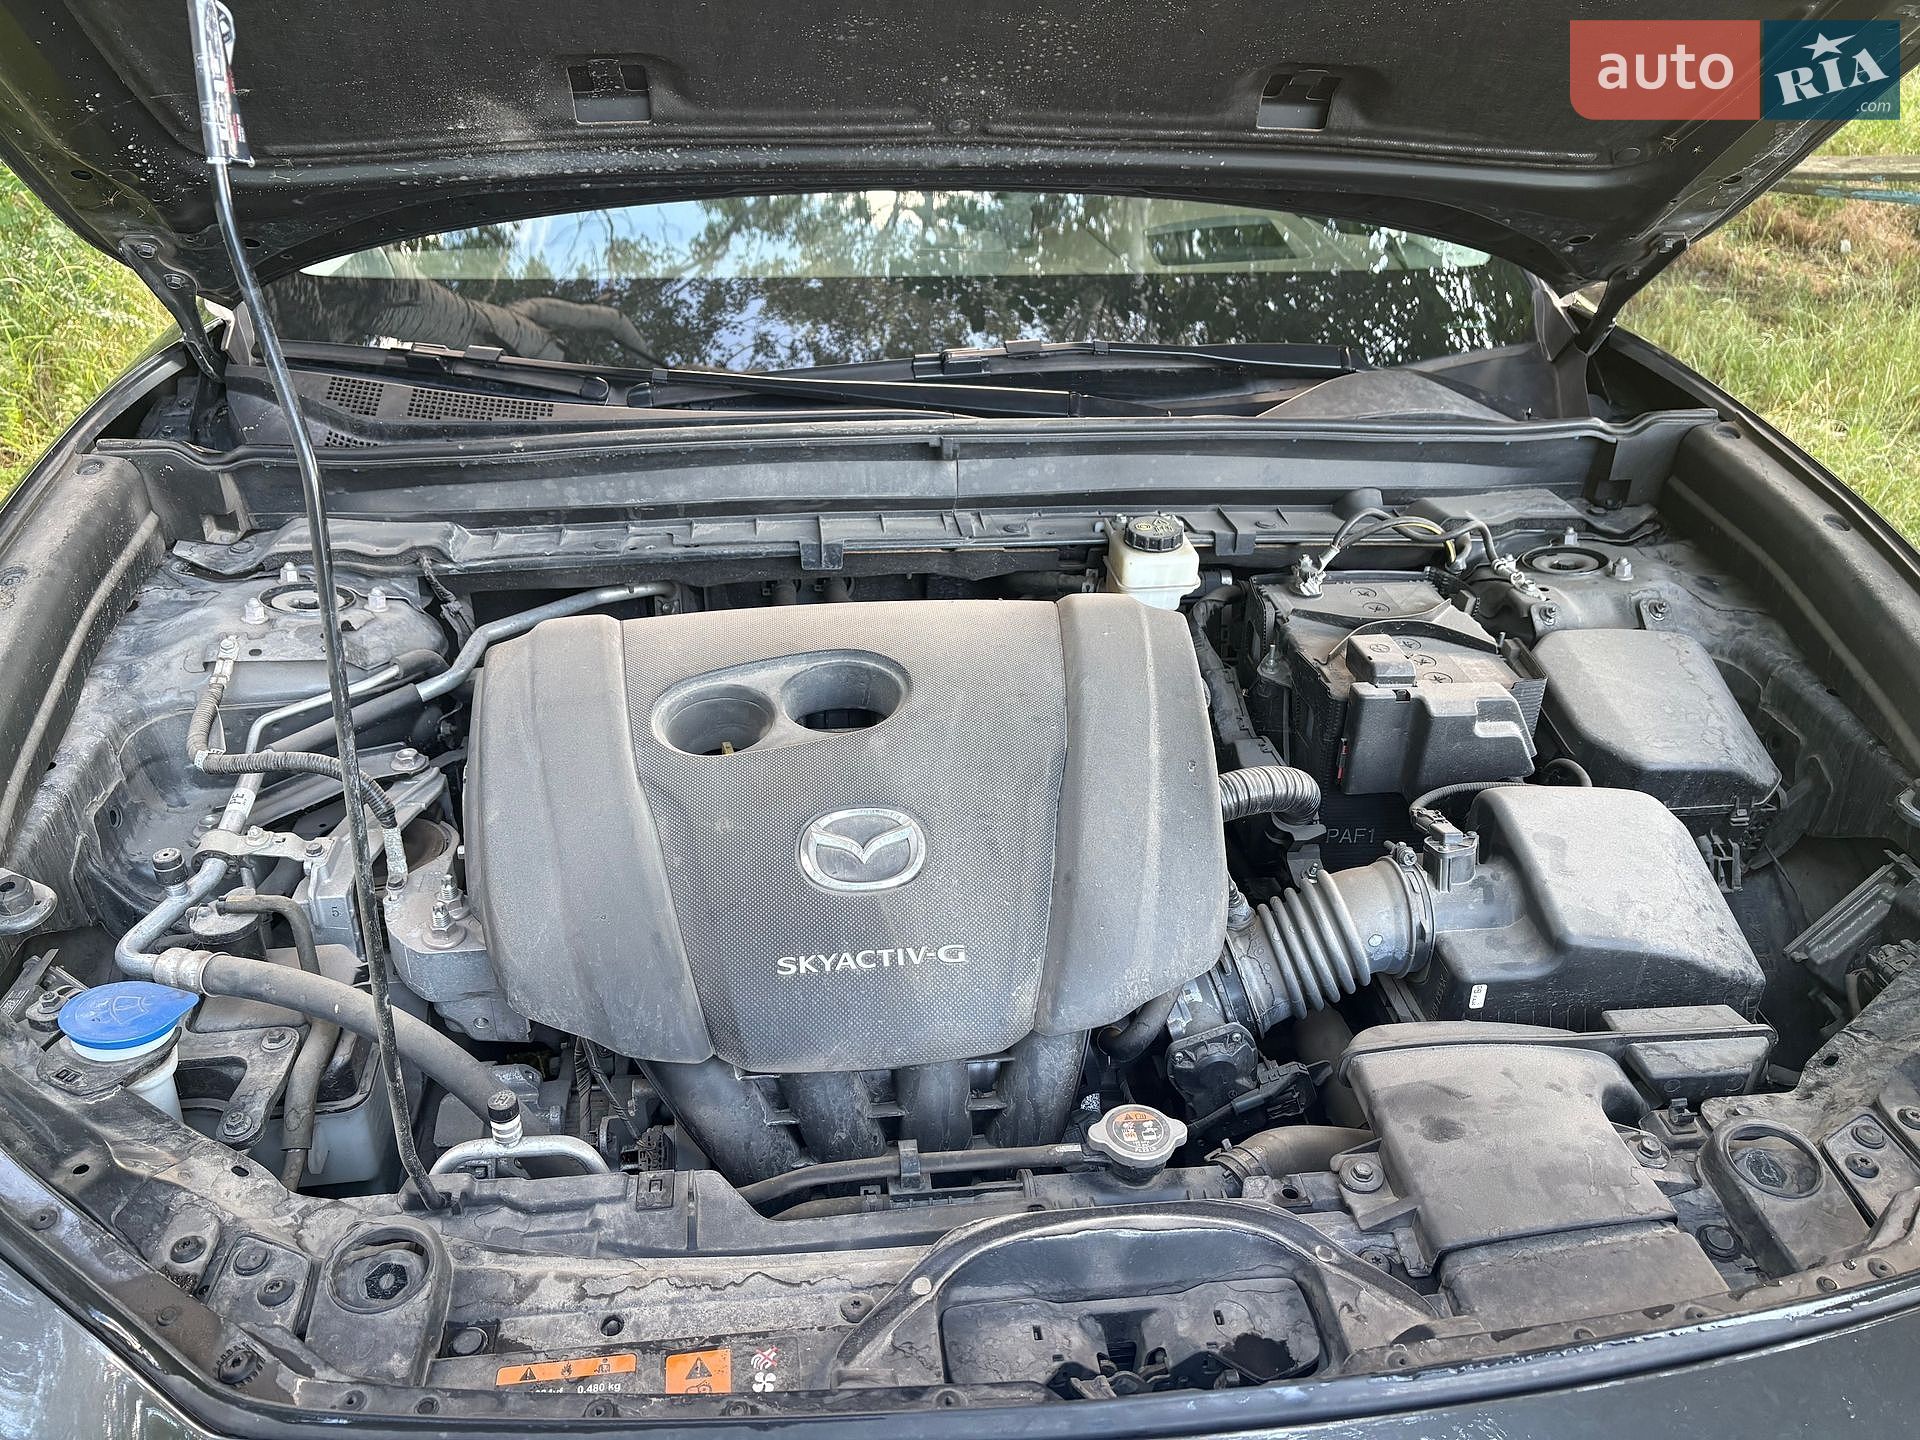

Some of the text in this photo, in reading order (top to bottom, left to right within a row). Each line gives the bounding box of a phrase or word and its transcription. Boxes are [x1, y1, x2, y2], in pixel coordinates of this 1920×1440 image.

[331, 906, 340, 918] 5
[776, 944, 967, 975] SKYACTIV-G
[577, 1382, 621, 1394] 0.480 kg
